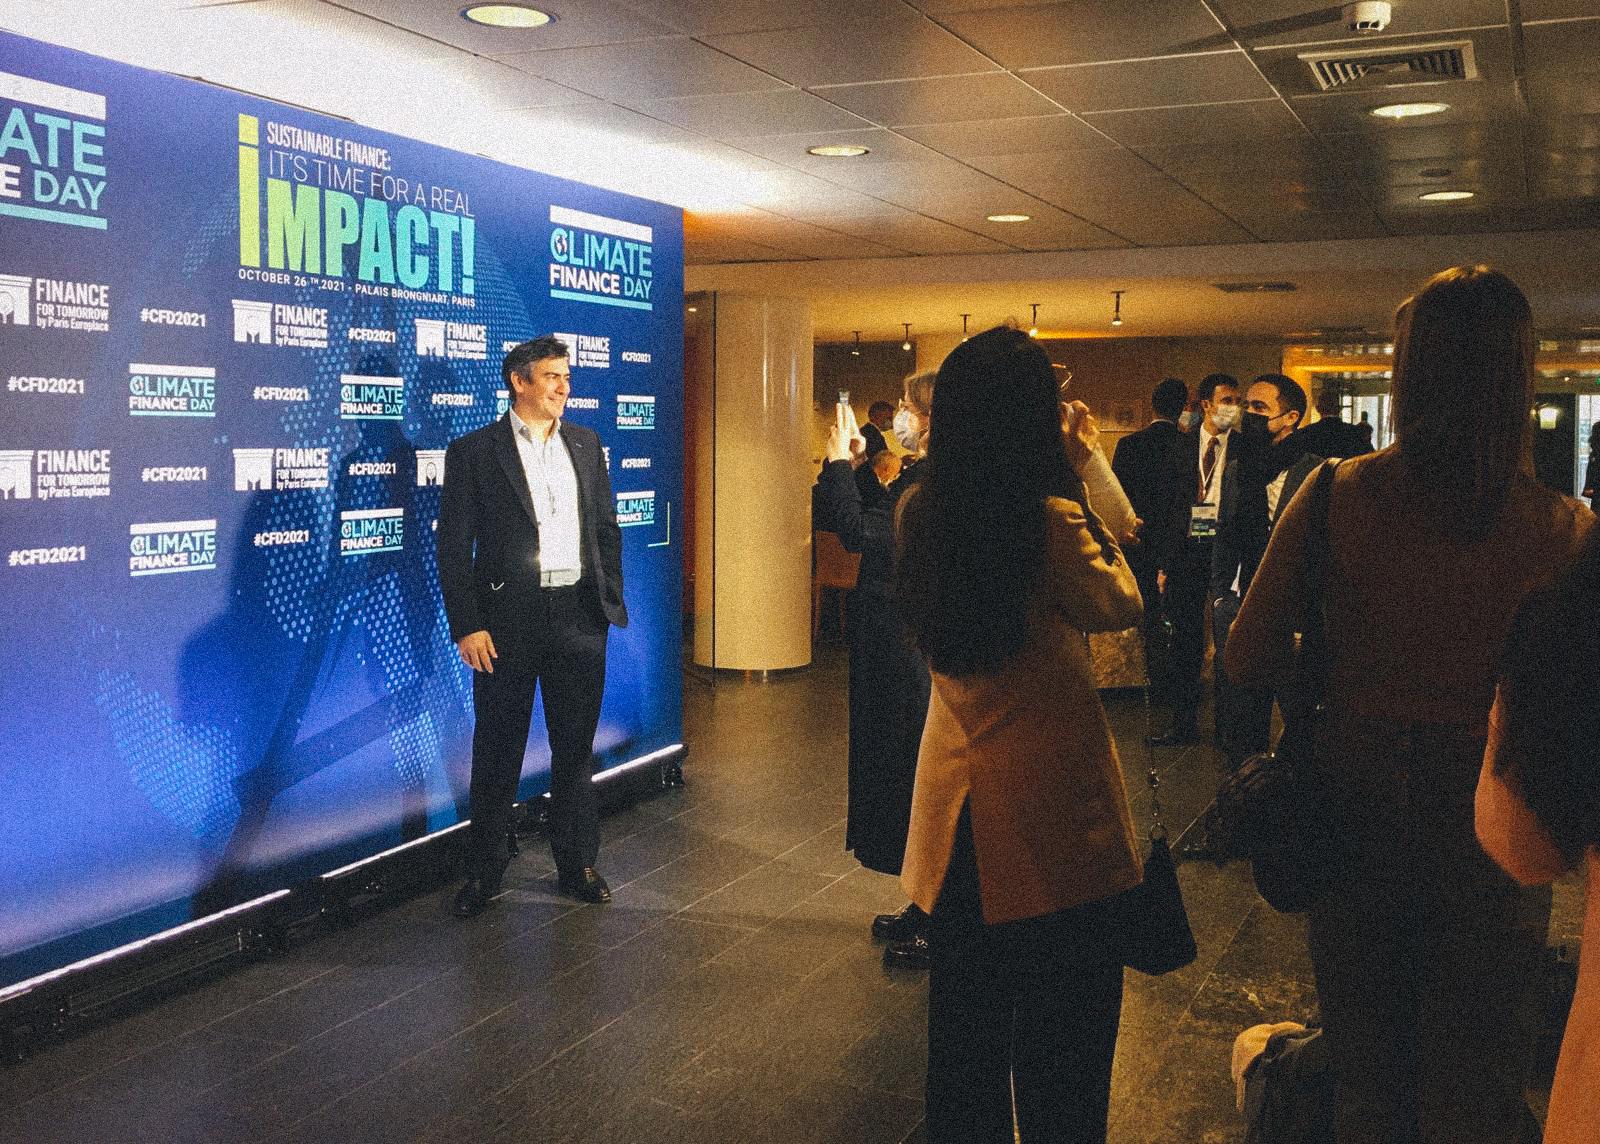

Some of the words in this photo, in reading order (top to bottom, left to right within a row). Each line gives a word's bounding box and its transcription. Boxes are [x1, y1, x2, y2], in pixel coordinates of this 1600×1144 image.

[267, 121, 342, 160] SUSTAINABLE
[343, 139, 391, 171] FINANCE:
[34, 170, 107, 211] DAY
[268, 150, 308, 182] IT'S
[313, 159, 364, 194] TIME
[371, 172, 408, 203] FOR
[414, 183, 427, 206] A
[431, 187, 475, 217] REAL
[550, 227, 652, 278] CLIMATE
[238, 268, 290, 285] OCTOBER
[294, 275, 307, 287] 26
[355, 283, 389, 297] PALAIS
[452, 296, 475, 308] PARIS
[550, 264, 620, 295] FINANCE
[624, 276, 652, 299] DAY
[36, 278, 109, 307] FINANCE
[36, 303, 54, 316] FOR
[57, 304, 109, 320] TOMORROW
[140, 307, 206, 327] #CFD2021
[275, 303, 328, 328] FINANCE
[37, 316, 46, 329] by
[48, 317, 69, 329] Paris
[447, 321, 487, 342] FINANCE
[348, 328, 396, 343] #CFD2021
[578, 335, 610, 353] FINANCE
[7, 375, 84, 394] #CFD2021
[129, 375, 215, 398] CLIMATE
[253, 386, 309, 401] #CFD2021
[341, 384, 403, 403] CLIMATE
[129, 396, 188, 411] FINANCE
[190, 398, 215, 411] DAY
[341, 402, 383, 414] FINANCE
[384, 403, 403, 414] DAY
[432, 393, 473, 406] #CFD2021
[617, 402, 655, 417] CLIMATE
[643, 416, 655, 426] DAY
[37, 449, 110, 473] FINANCE
[275, 448, 329, 468] FINANCE
[141, 467, 207, 482] #CFD2021
[348, 462, 397, 476] #CFD2021
[38, 474, 56, 487] FOR
[57, 473, 110, 486] TOMORROW
[38, 488, 48, 500] by
[49, 486, 71, 498] Paris
[617, 499, 655, 514] CLIMATE
[643, 511, 655, 521] DAY
[341, 518, 404, 538] CLIMATE
[130, 530, 216, 556] CLIMATE
[253, 530, 309, 546] #CFD2021
[341, 536, 384, 551] FINANCE
[385, 534, 403, 546] DAY
[8, 546, 86, 567] #CFD2021
[130, 552, 189, 570] FINANCE
[191, 550, 216, 565] DAY
